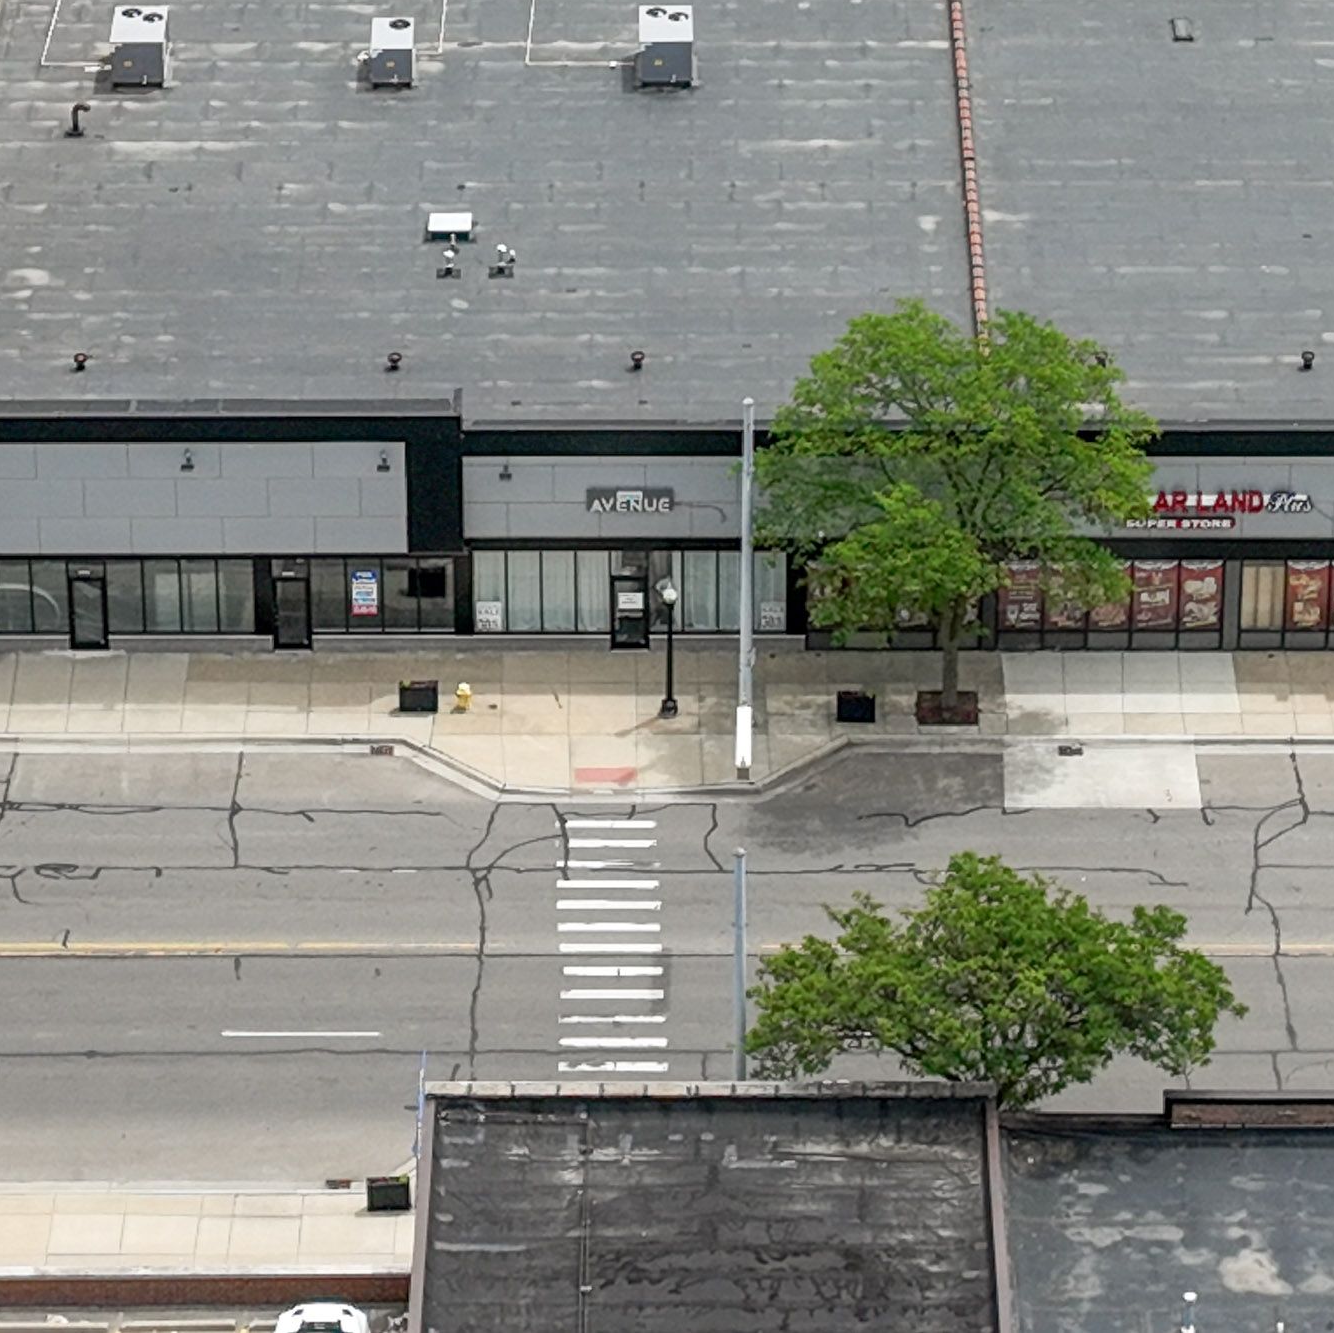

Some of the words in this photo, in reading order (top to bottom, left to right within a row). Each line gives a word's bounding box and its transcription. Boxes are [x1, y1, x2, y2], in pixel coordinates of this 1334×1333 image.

[589, 497, 671, 513] AVENUE
[1196, 489, 1264, 514] LAND
[1181, 518, 1232, 529] STORE
